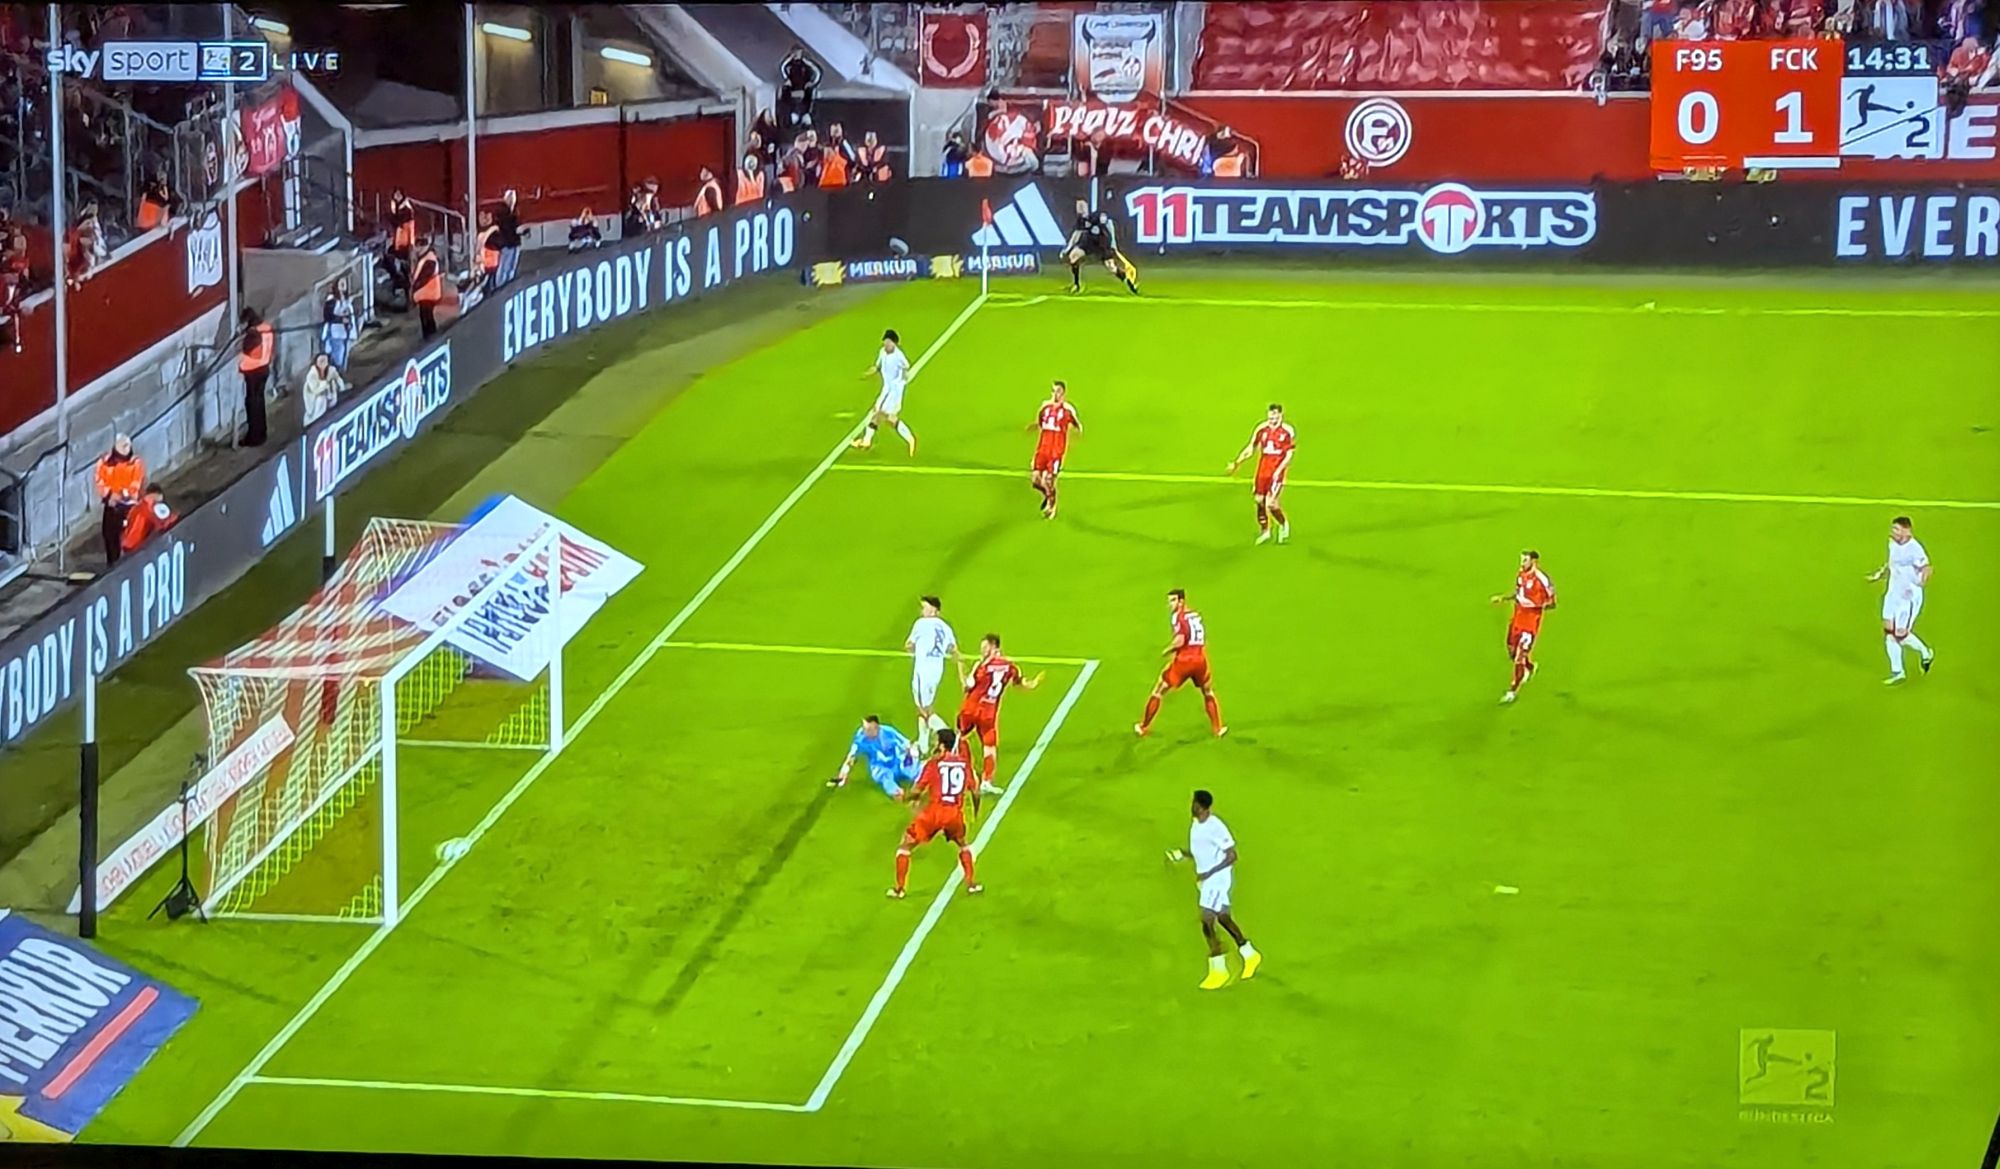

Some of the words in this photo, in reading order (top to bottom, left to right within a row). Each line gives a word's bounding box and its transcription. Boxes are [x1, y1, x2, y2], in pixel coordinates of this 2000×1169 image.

[47, 44, 99, 78] sky
[111, 49, 190, 76] sport
[239, 53, 256, 71] 2
[271, 53, 339, 71] LIVE
[1676, 48, 1723, 72] F95
[1770, 48, 1819, 71] FCK
[1847, 47, 1931, 70] 14:31
[1677, 90, 1720, 145] 0
[1773, 91, 1814, 144] 1
[1836, 195, 2000, 257] EVER
[849, 258, 918, 277] MERKUR
[503, 247, 651, 363] EVERYBODY
[665, 236, 692, 301] IS
[704, 226, 722, 288] A
[734, 207, 794, 279] PRO
[86, 595, 109, 675] IS
[118, 578, 133, 659] A
[142, 540, 184, 640] PRO
[939, 766, 966, 796] 19
